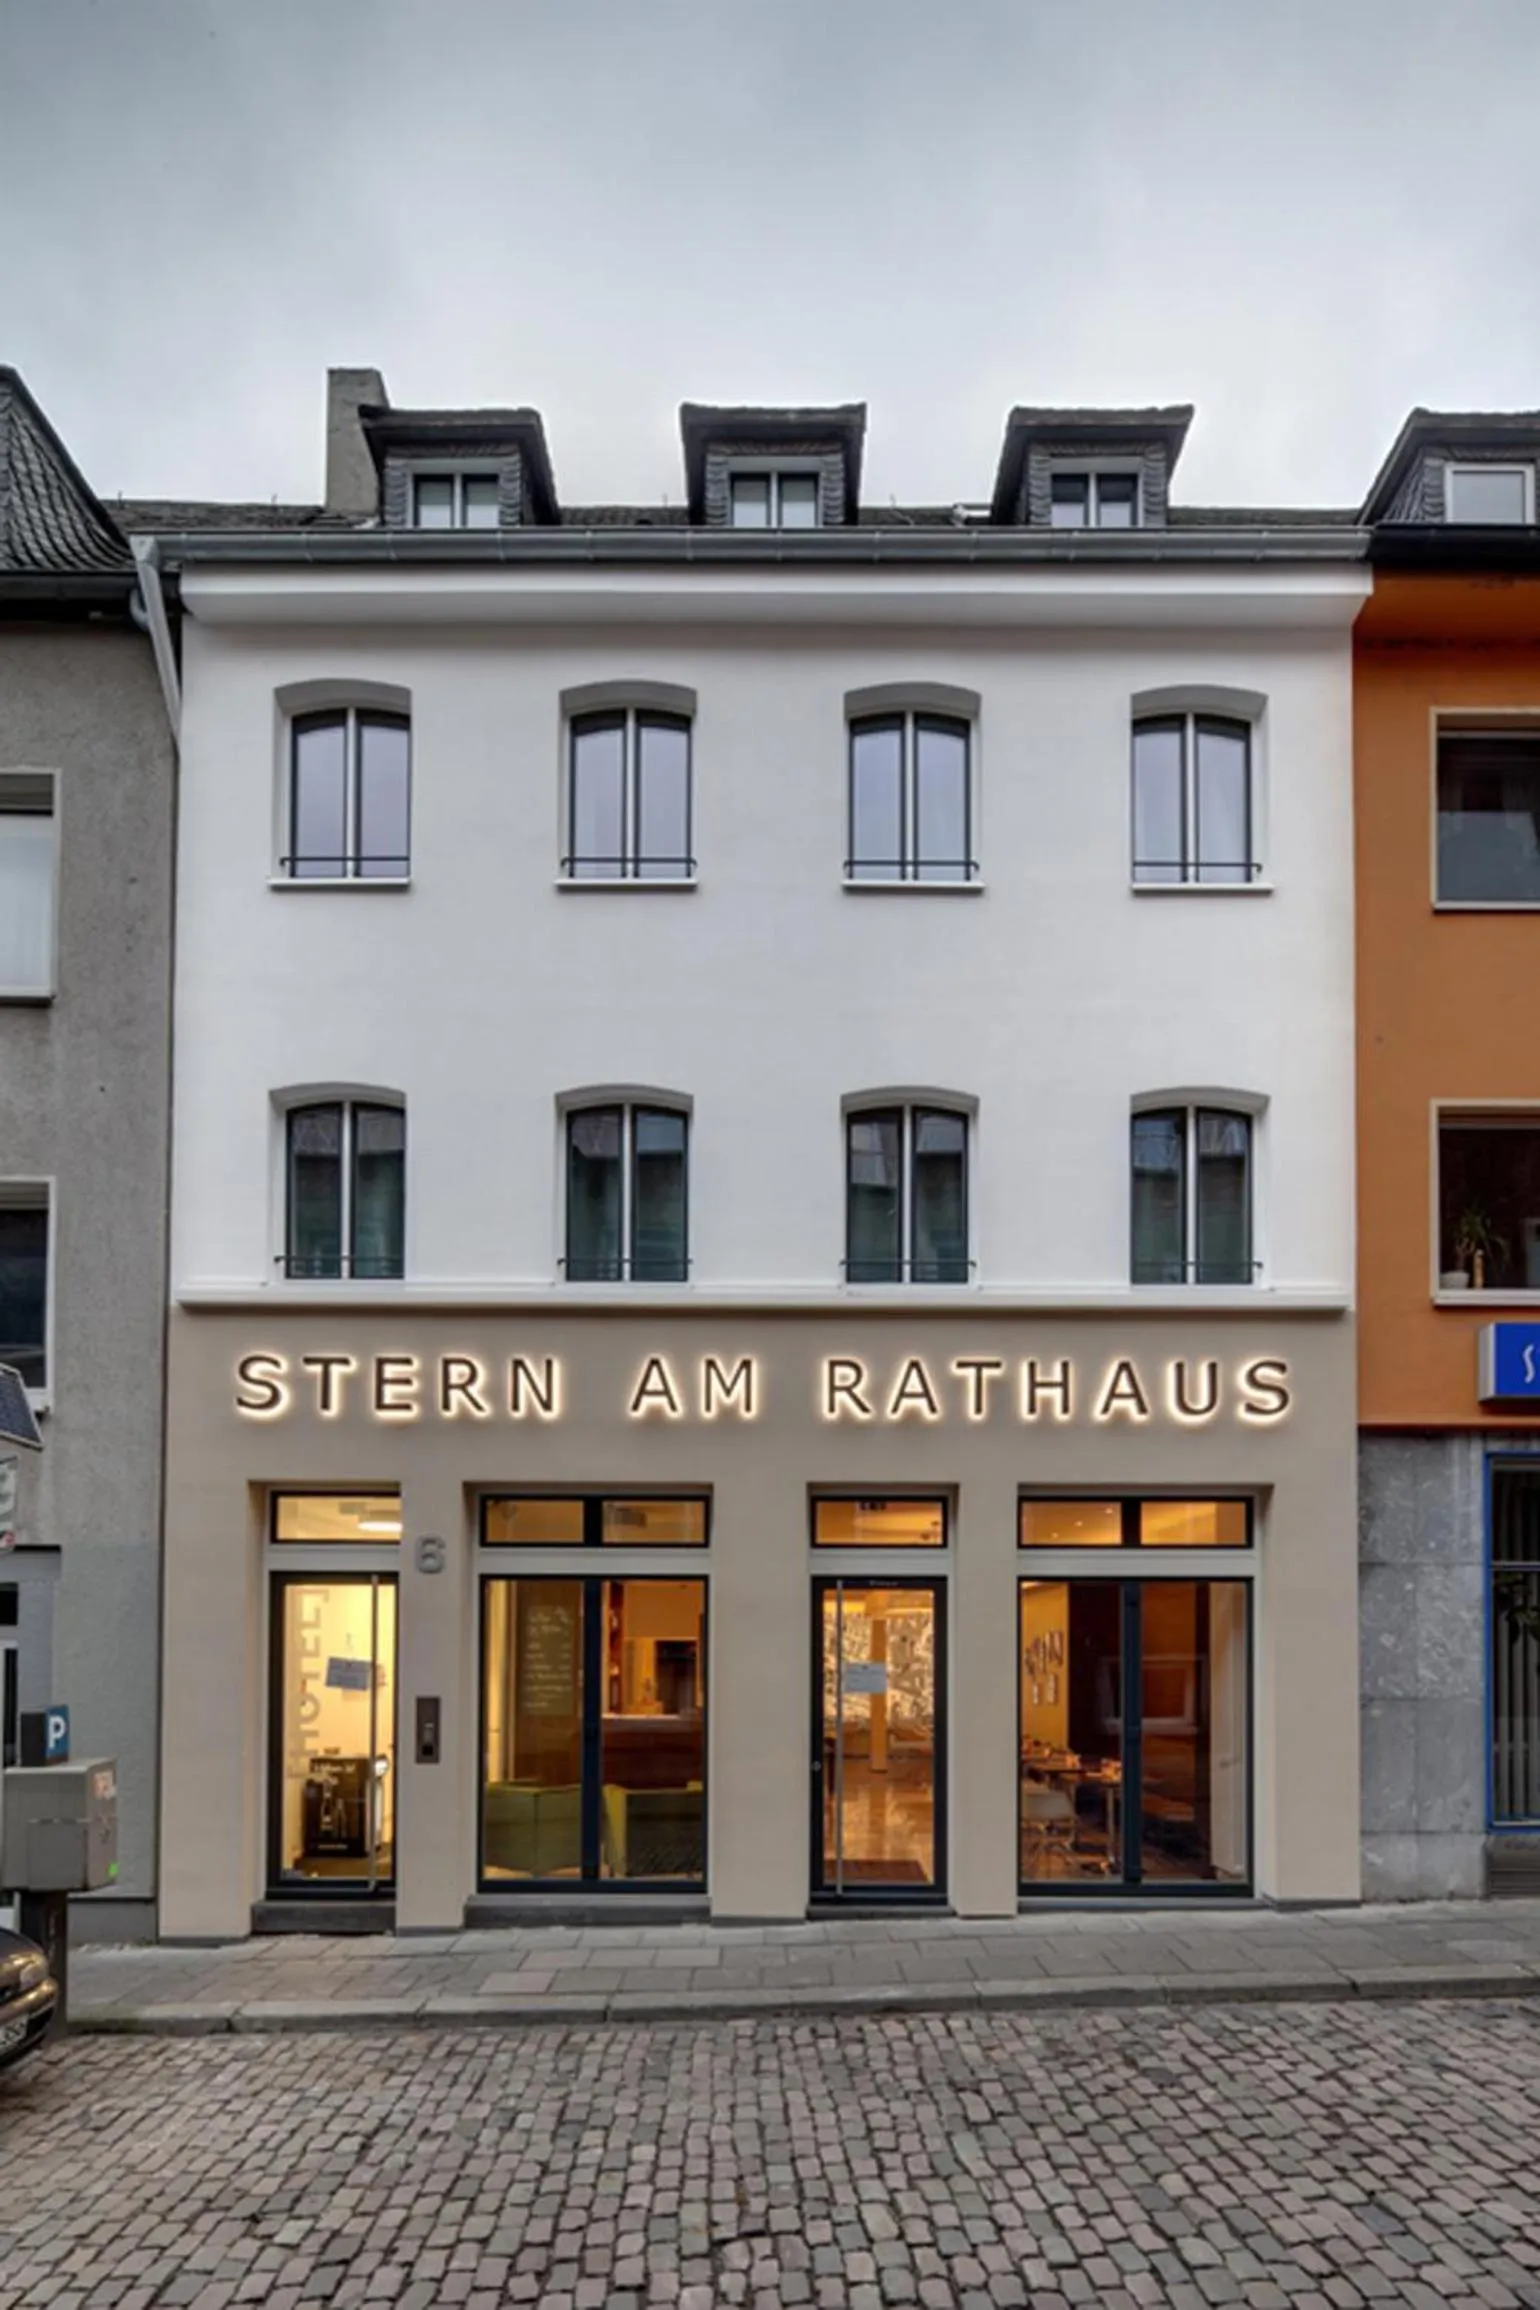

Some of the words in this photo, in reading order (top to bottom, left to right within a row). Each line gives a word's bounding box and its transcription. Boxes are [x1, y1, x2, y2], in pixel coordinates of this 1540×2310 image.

[236, 1355, 553, 1412] STERN
[631, 1357, 754, 1413] AM
[828, 1359, 1291, 1416] RATHAUS
[413, 1535, 446, 1575] 6
[48, 1714, 66, 1749] P
